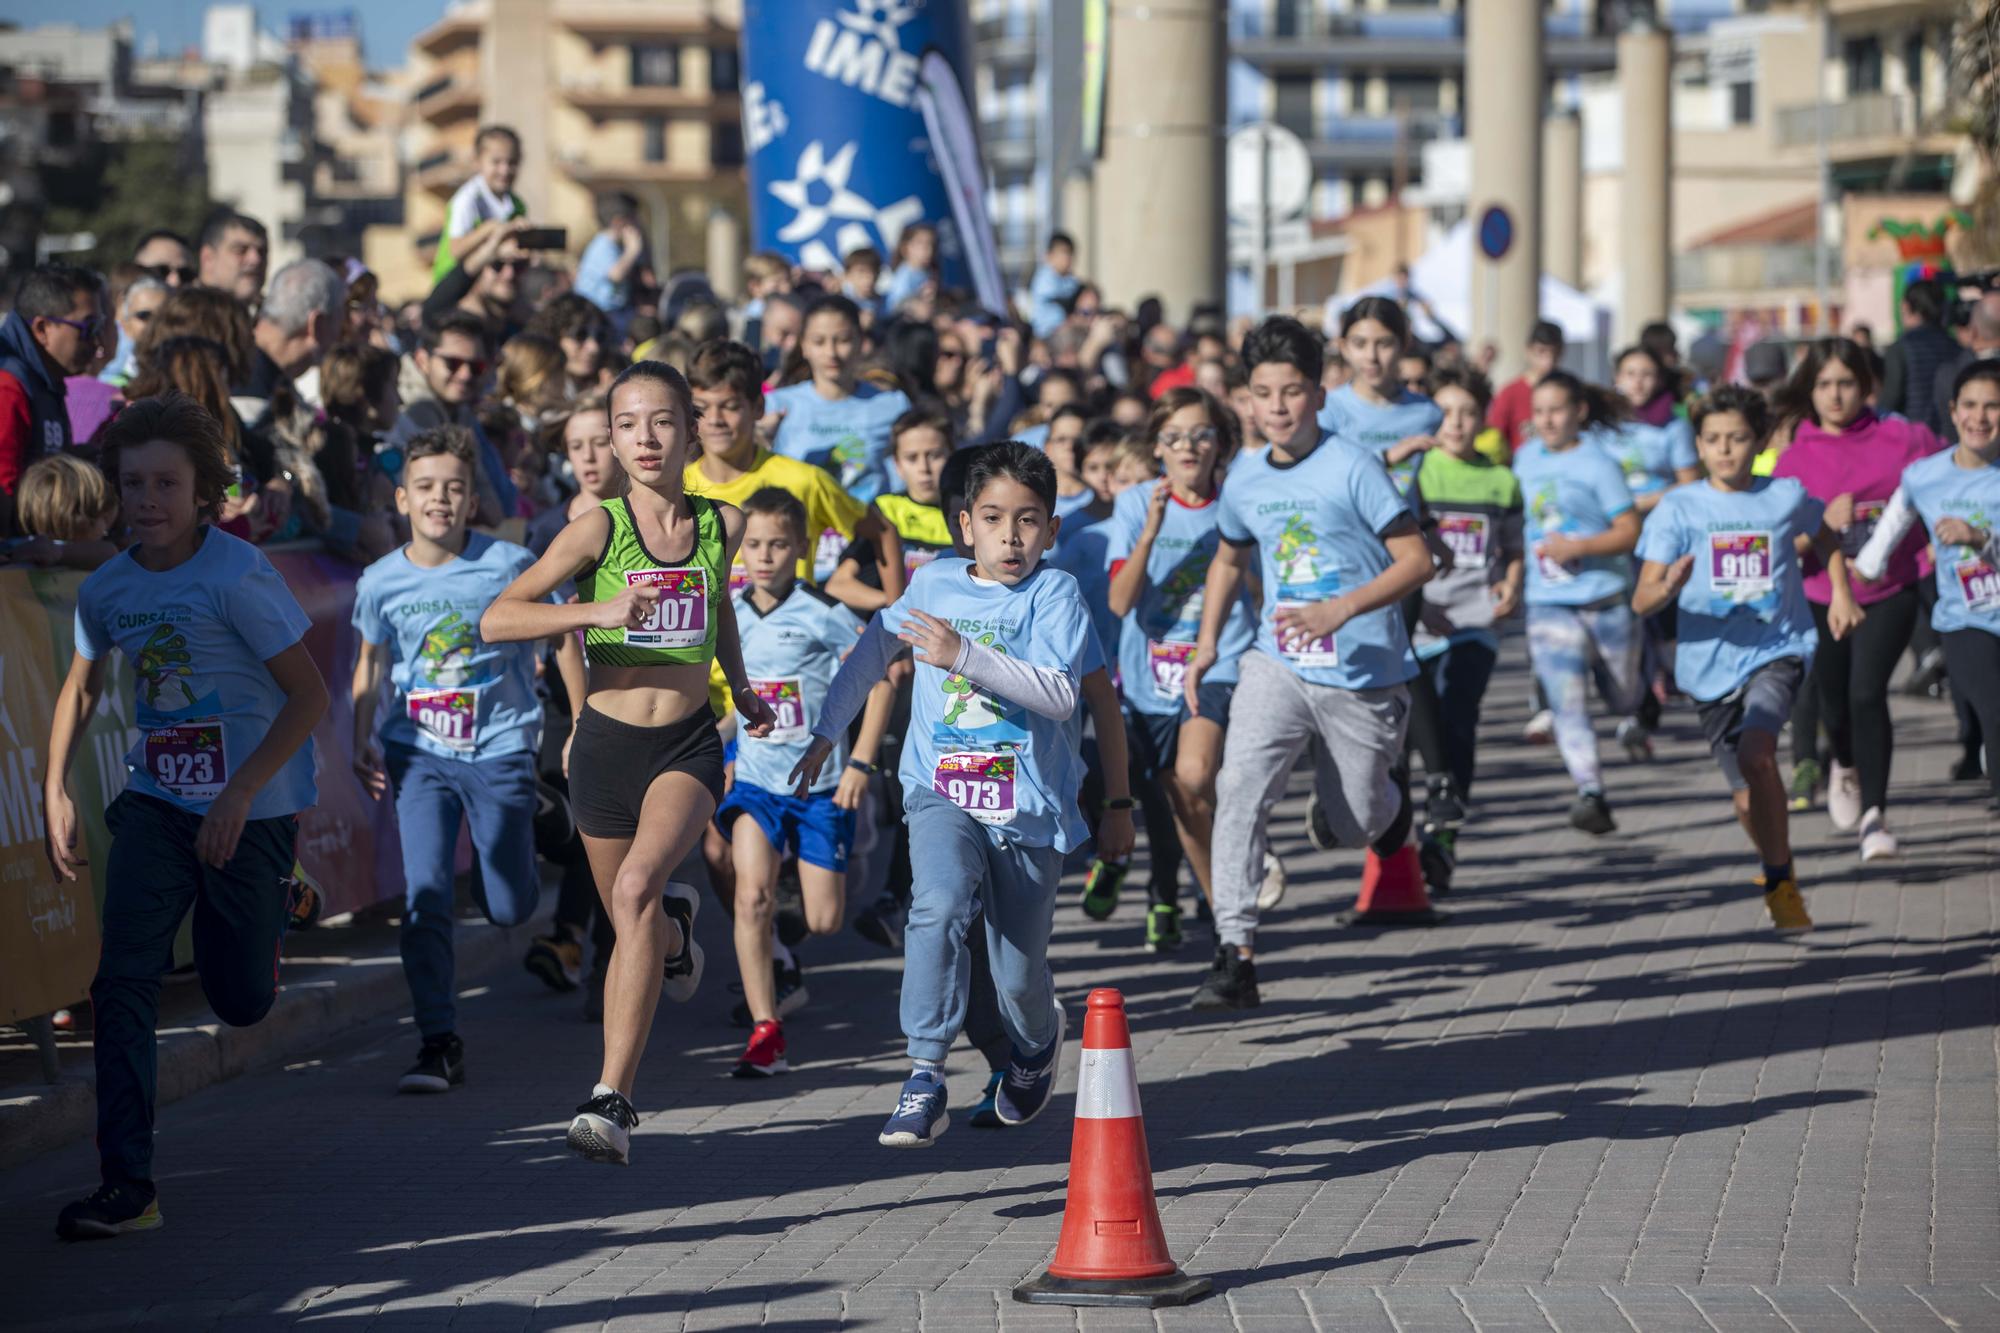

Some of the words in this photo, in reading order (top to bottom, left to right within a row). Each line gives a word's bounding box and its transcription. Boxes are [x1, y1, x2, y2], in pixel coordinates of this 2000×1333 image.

[1722, 553, 1762, 578] 916
[118, 612, 166, 628] CURSA
[401, 599, 453, 617] CURSA
[157, 752, 214, 784] 923
[948, 778, 1001, 809] 973
